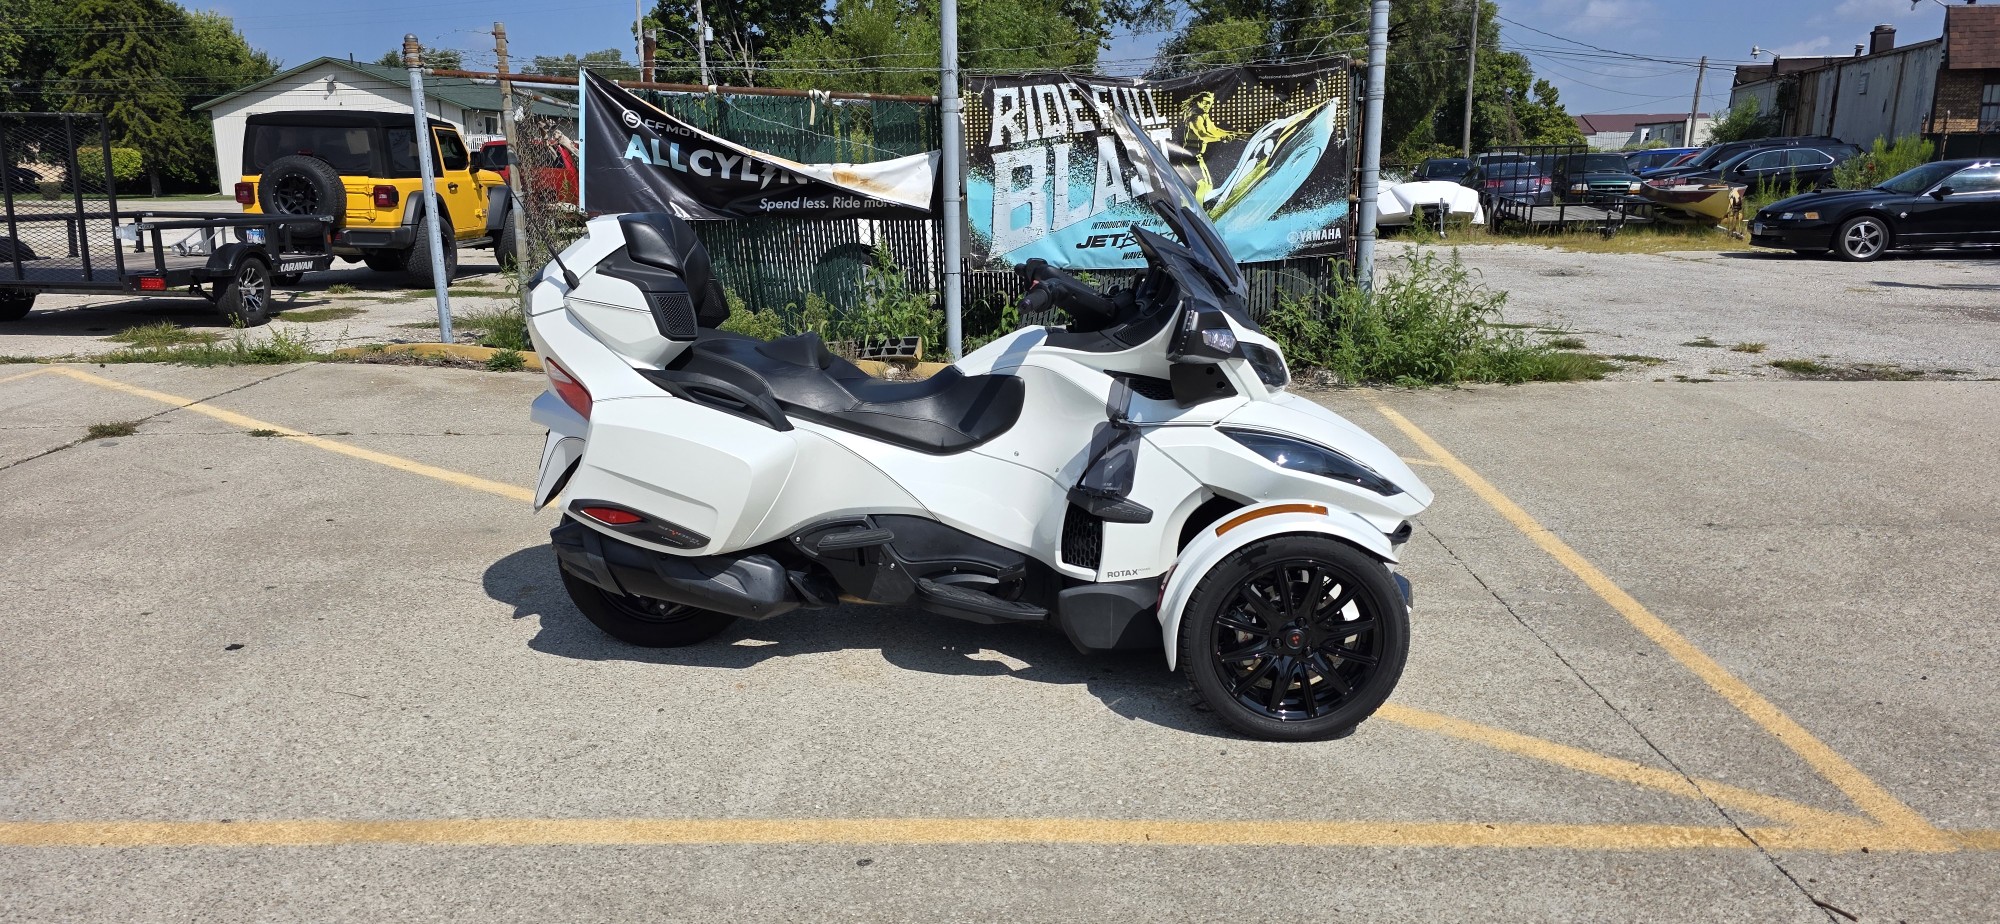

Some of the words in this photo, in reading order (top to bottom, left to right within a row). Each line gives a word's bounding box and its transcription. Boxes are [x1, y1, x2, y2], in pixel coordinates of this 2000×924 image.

[989, 83, 1096, 147] RIDE
[1088, 84, 1168, 130] FULL
[986, 128, 1173, 260] BLAST
[759, 197, 801, 212] Spend
[803, 197, 829, 209] less.
[832, 196, 861, 209] Ride
[1091, 220, 1131, 230] INTRODUCING
[1300, 227, 1342, 242] YAMAHA
[1107, 569, 1138, 578] ROTAX
